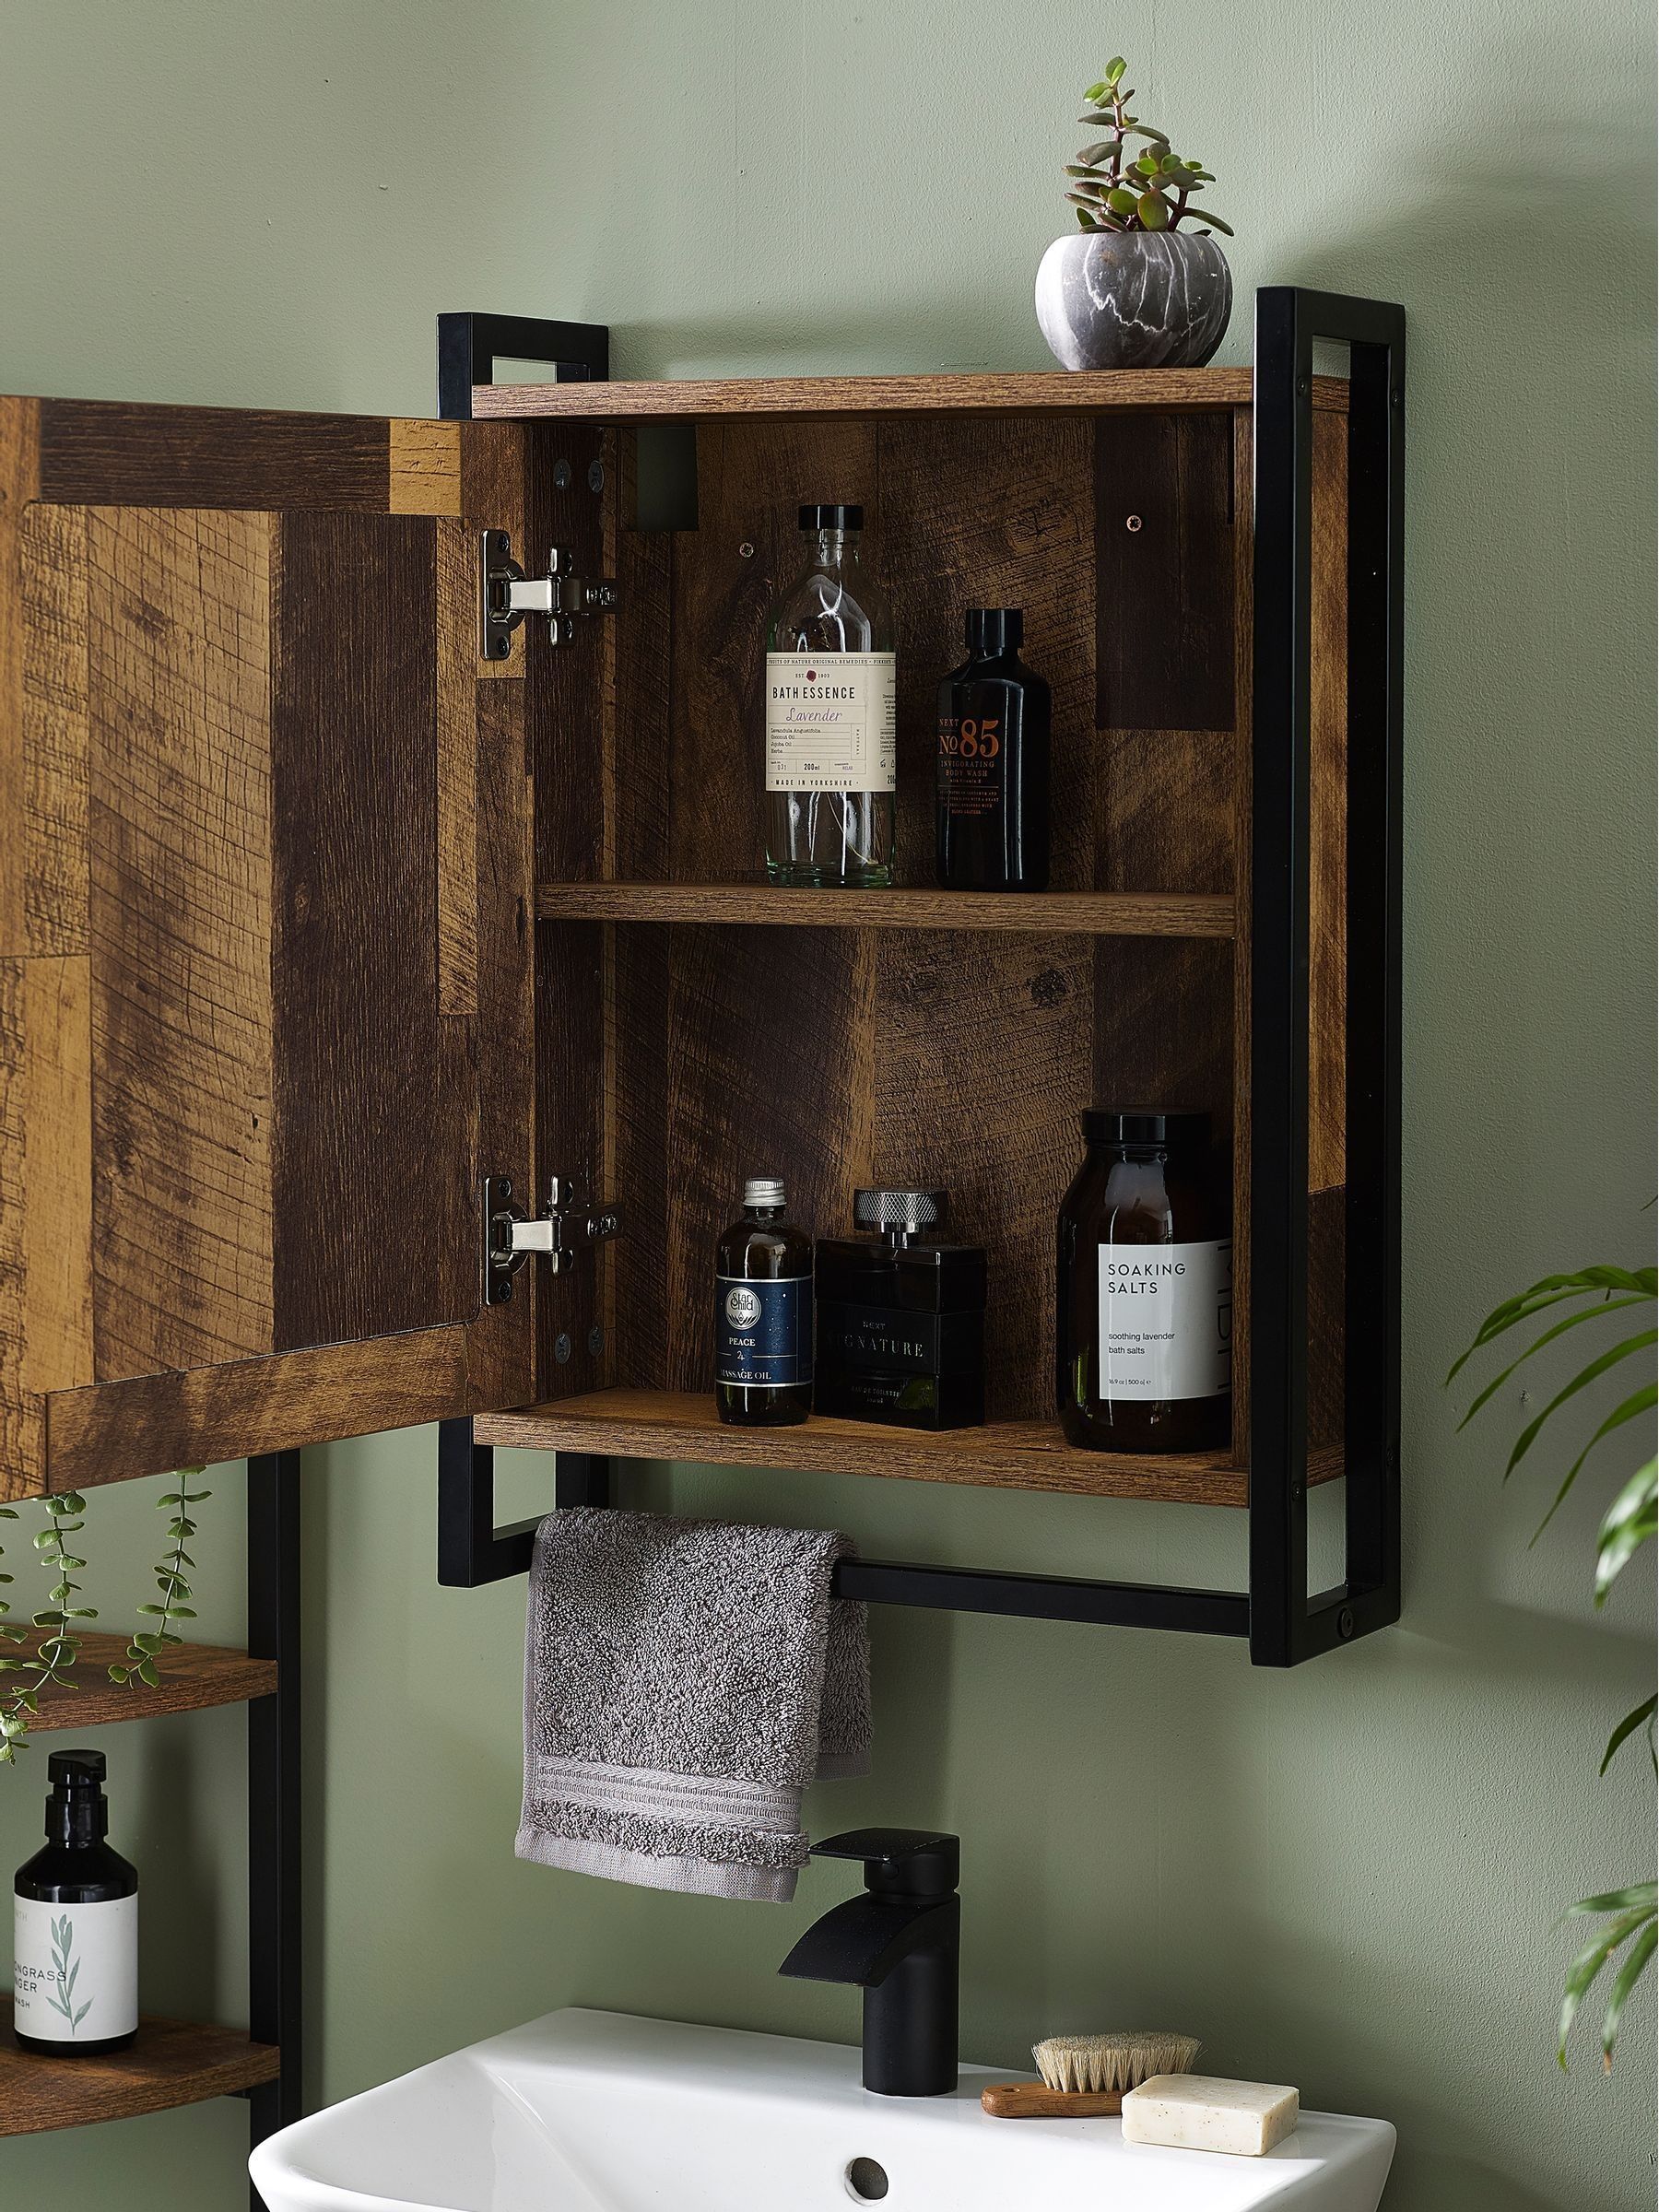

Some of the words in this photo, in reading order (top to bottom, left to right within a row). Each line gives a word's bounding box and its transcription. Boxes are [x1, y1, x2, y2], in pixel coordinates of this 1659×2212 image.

[772, 687, 799, 700] BATH
[803, 687, 855, 700] ESSENCE
[785, 707, 842, 723] Lavender
[939, 718, 959, 727] NEXT
[959, 719, 999, 758] 85
[940, 760, 994, 769] INVIGORATING
[1108, 1263, 1186, 1277] SOAKING
[1108, 1282, 1158, 1294] SALTS
[728, 1337, 756, 1347] PEACE
[1108, 1333, 1141, 1342] soothing
[1126, 1347, 1145, 1355] salts
[754, 1371, 771, 1380] OIL
